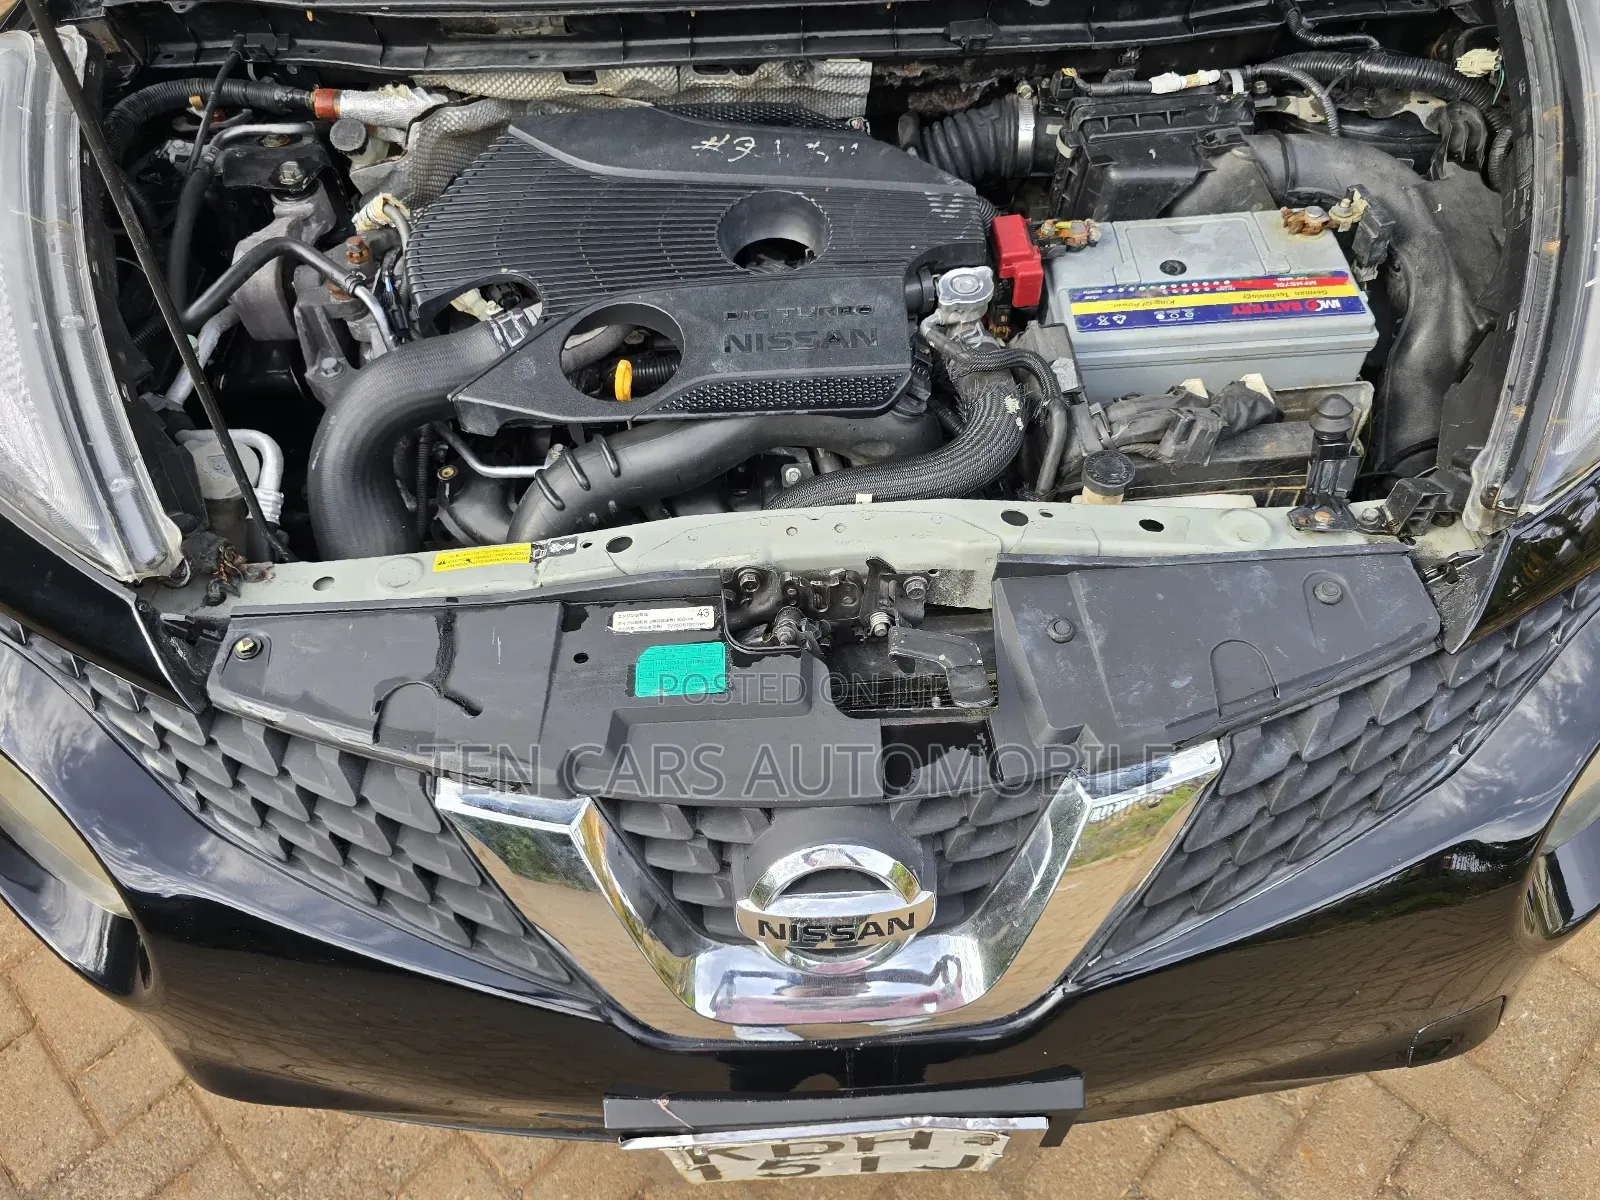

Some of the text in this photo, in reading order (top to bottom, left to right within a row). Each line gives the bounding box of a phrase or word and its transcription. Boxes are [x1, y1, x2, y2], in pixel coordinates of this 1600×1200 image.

[1242, 291, 1290, 300] Technology
[724, 304, 875, 321] DIG TURBO
[1232, 299, 1302, 315] BATTERY
[724, 327, 879, 354] NISSAN
[697, 608, 710, 618] 43
[757, 912, 916, 943] NISSAN
